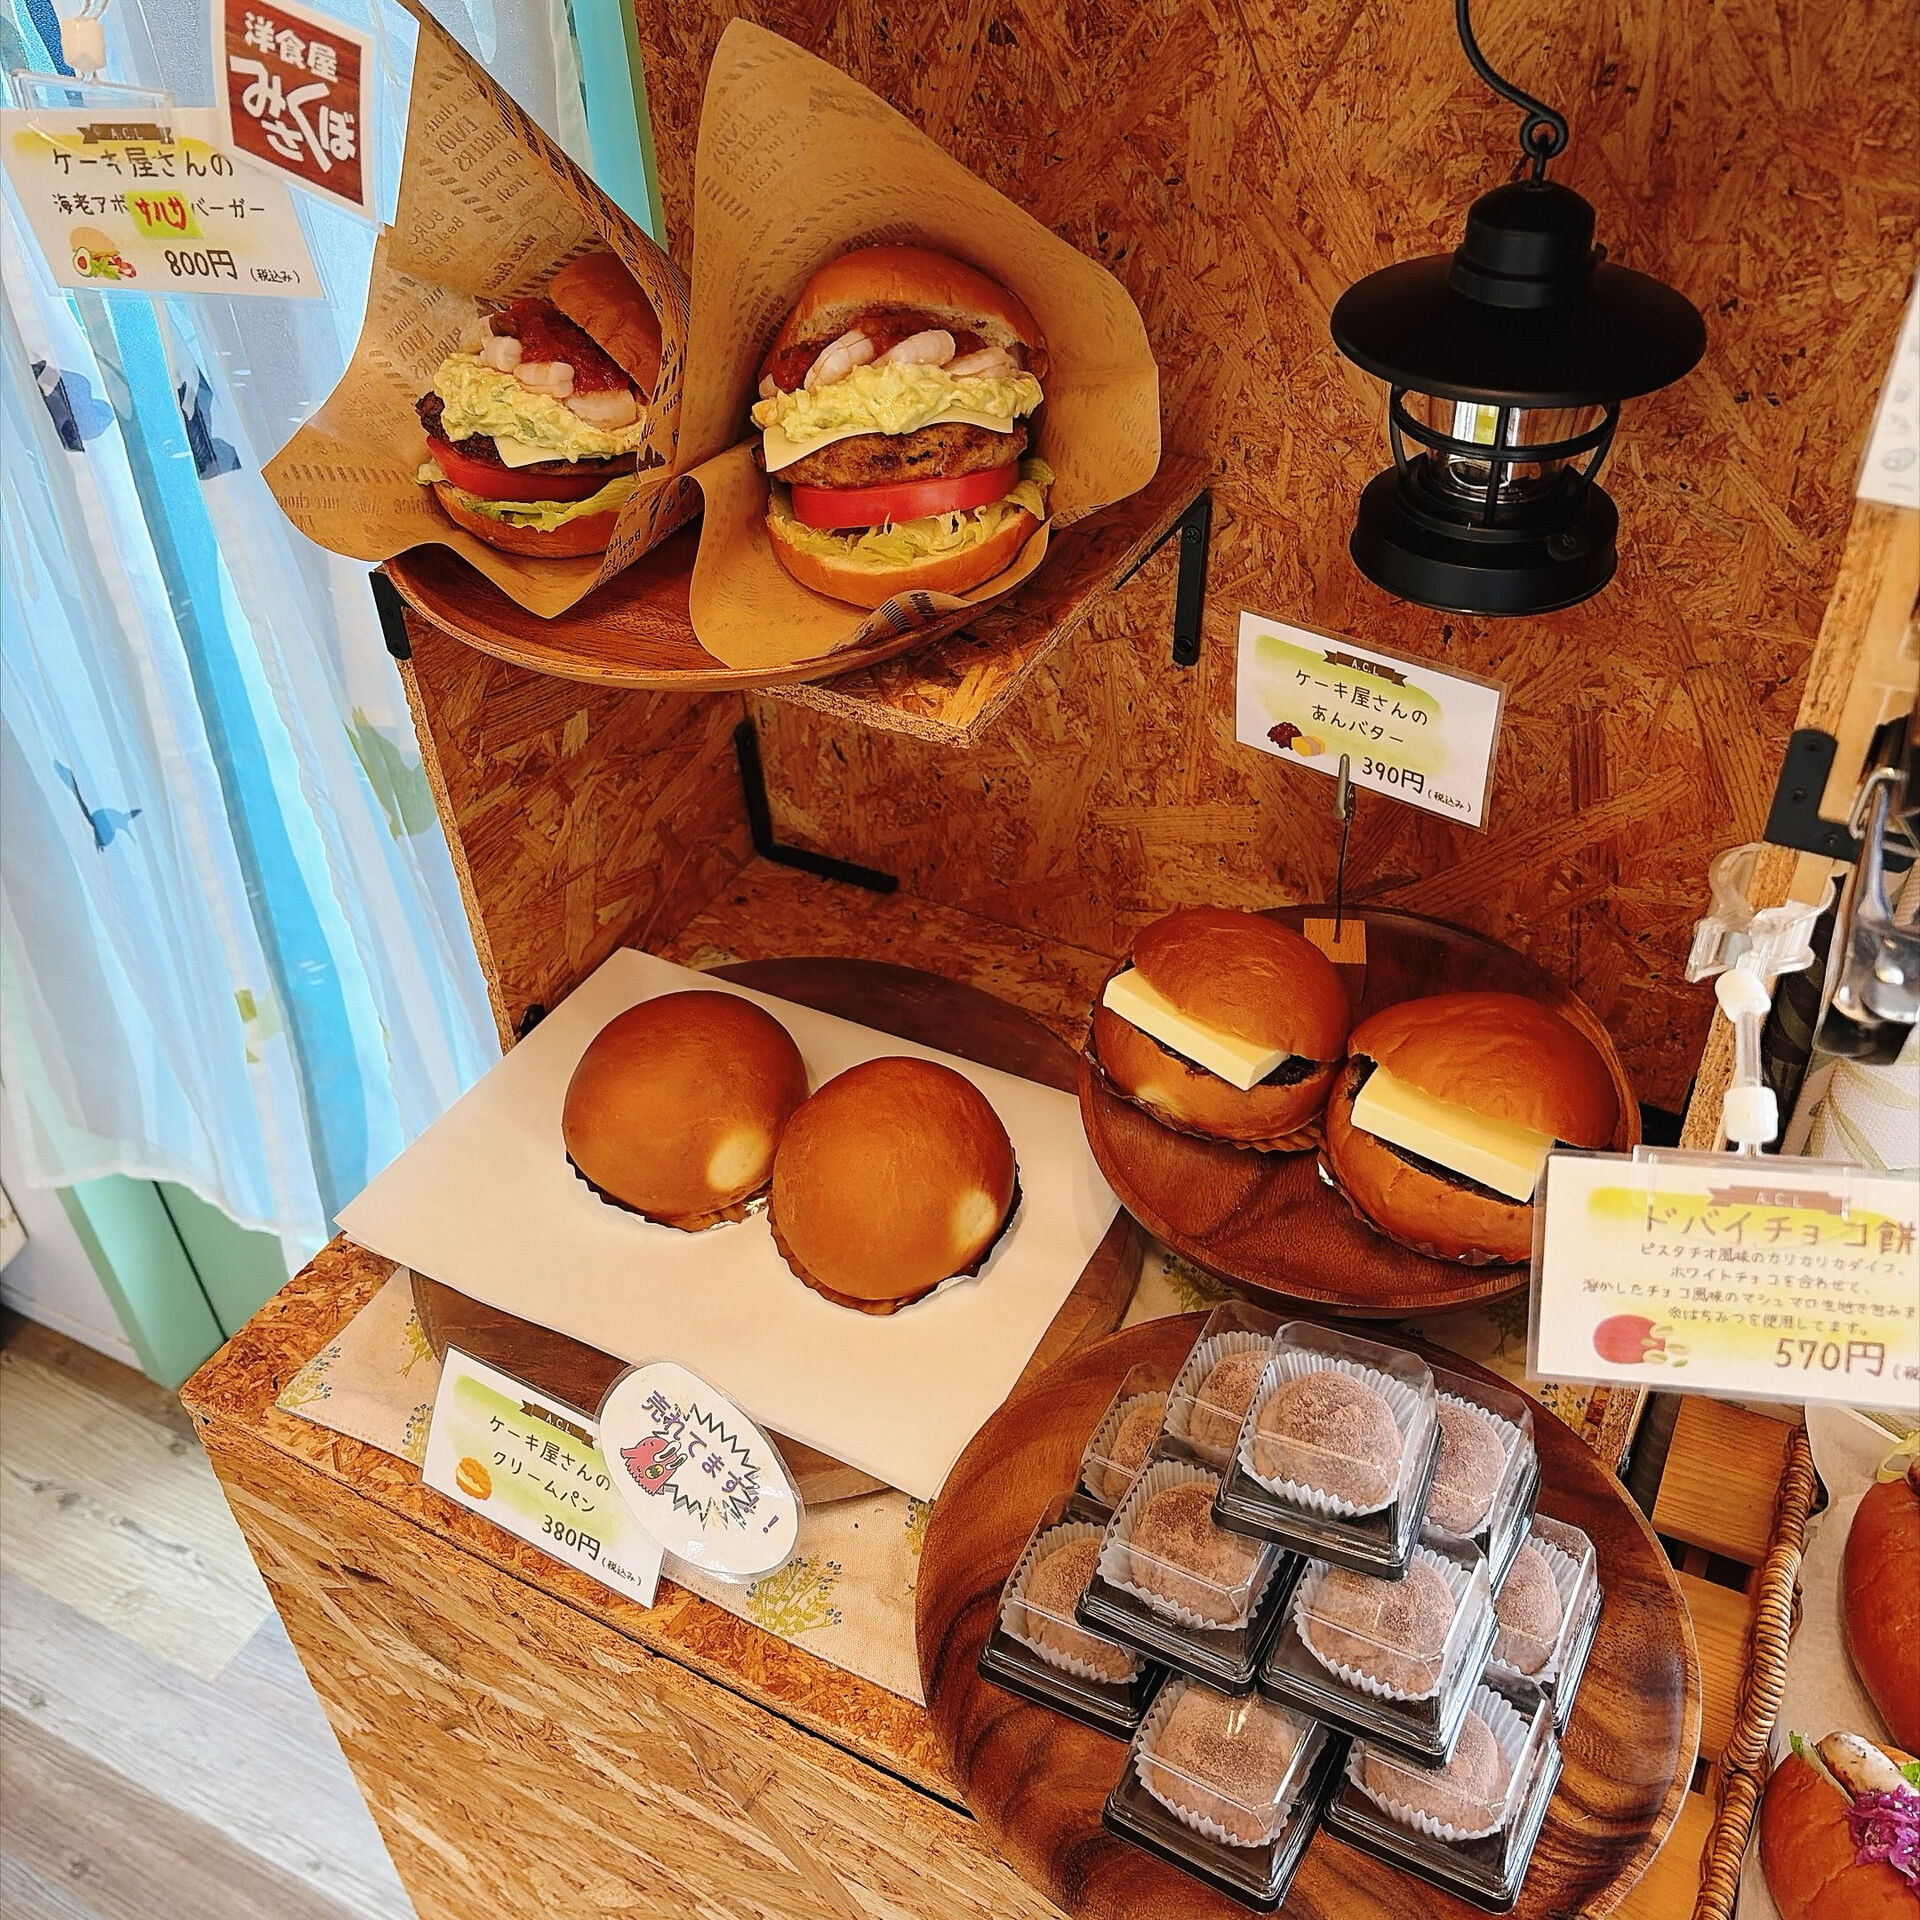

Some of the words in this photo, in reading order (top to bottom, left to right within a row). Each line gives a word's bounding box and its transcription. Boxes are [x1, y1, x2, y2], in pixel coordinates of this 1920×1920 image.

[244, 12, 338, 83] 洋食屋
[52, 147, 234, 178] ケーキ屋さんの
[164, 249, 238, 280] 800円
[1351, 658, 1379, 677] A.C.L
[1294, 668, 1429, 726] ケーキ屋さんの
[1311, 704, 1404, 744] あんバター
[1362, 756, 1426, 795] 390円
[1427, 789, 1472, 813] (税込み)
[1646, 1203, 1917, 1256] ドバイチョコ餅
[1774, 1337, 1885, 1377] 570円
[545, 1413, 572, 1434] A.C.L
[489, 1415, 611, 1491] ケーキ屋さんの
[493, 1450, 596, 1513] クリームパン
[541, 1514, 601, 1561] 380円
[601, 1557, 642, 1586] (税込み)
